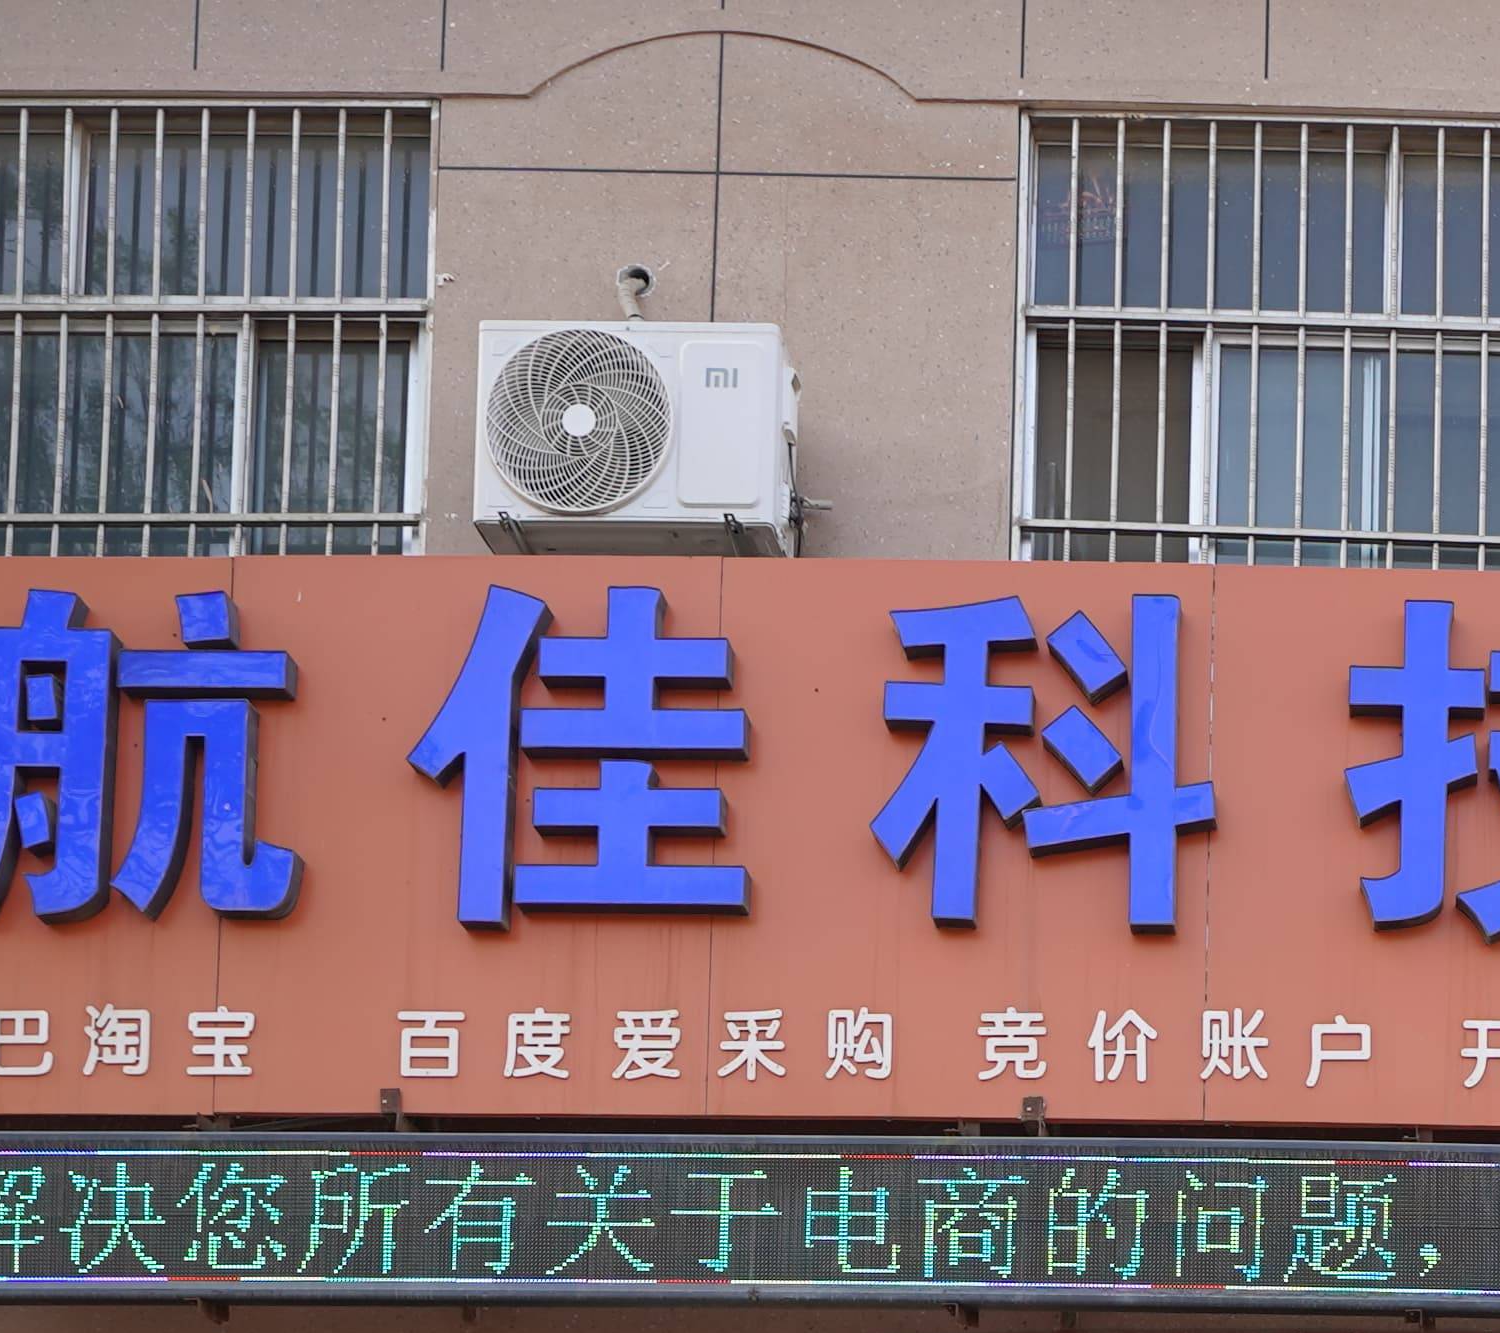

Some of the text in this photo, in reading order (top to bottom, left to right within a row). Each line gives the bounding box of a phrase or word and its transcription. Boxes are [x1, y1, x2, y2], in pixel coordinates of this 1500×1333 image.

[396, 1006, 895, 1081] 百度爱采购
[975, 1008, 1375, 1088] 竞价账户
